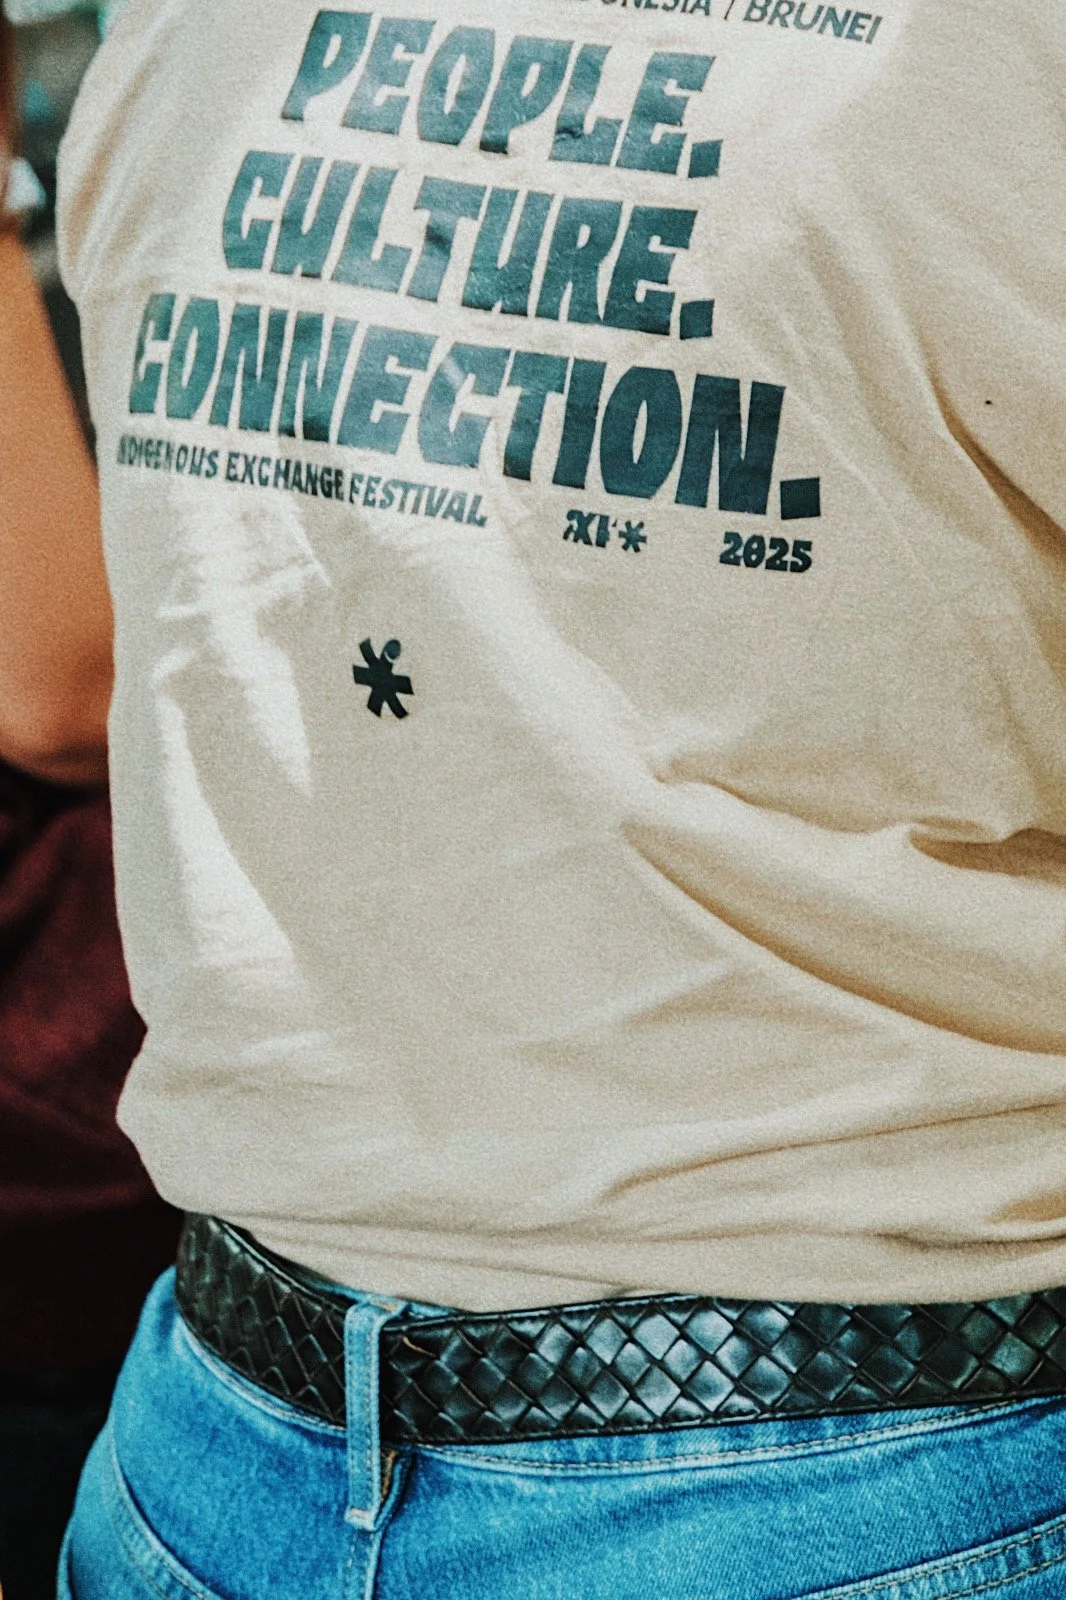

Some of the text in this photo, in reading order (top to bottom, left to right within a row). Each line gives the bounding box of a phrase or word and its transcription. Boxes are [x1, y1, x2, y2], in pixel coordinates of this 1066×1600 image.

[280, 10, 723, 178] PEOPLE.
[221, 149, 715, 340] CULTURE.
[128, 293, 821, 520] CONNECTION.
[225, 450, 344, 501] EXCHANGE
[349, 472, 488, 527] FESTIVAL
[719, 531, 813, 573] 2025
